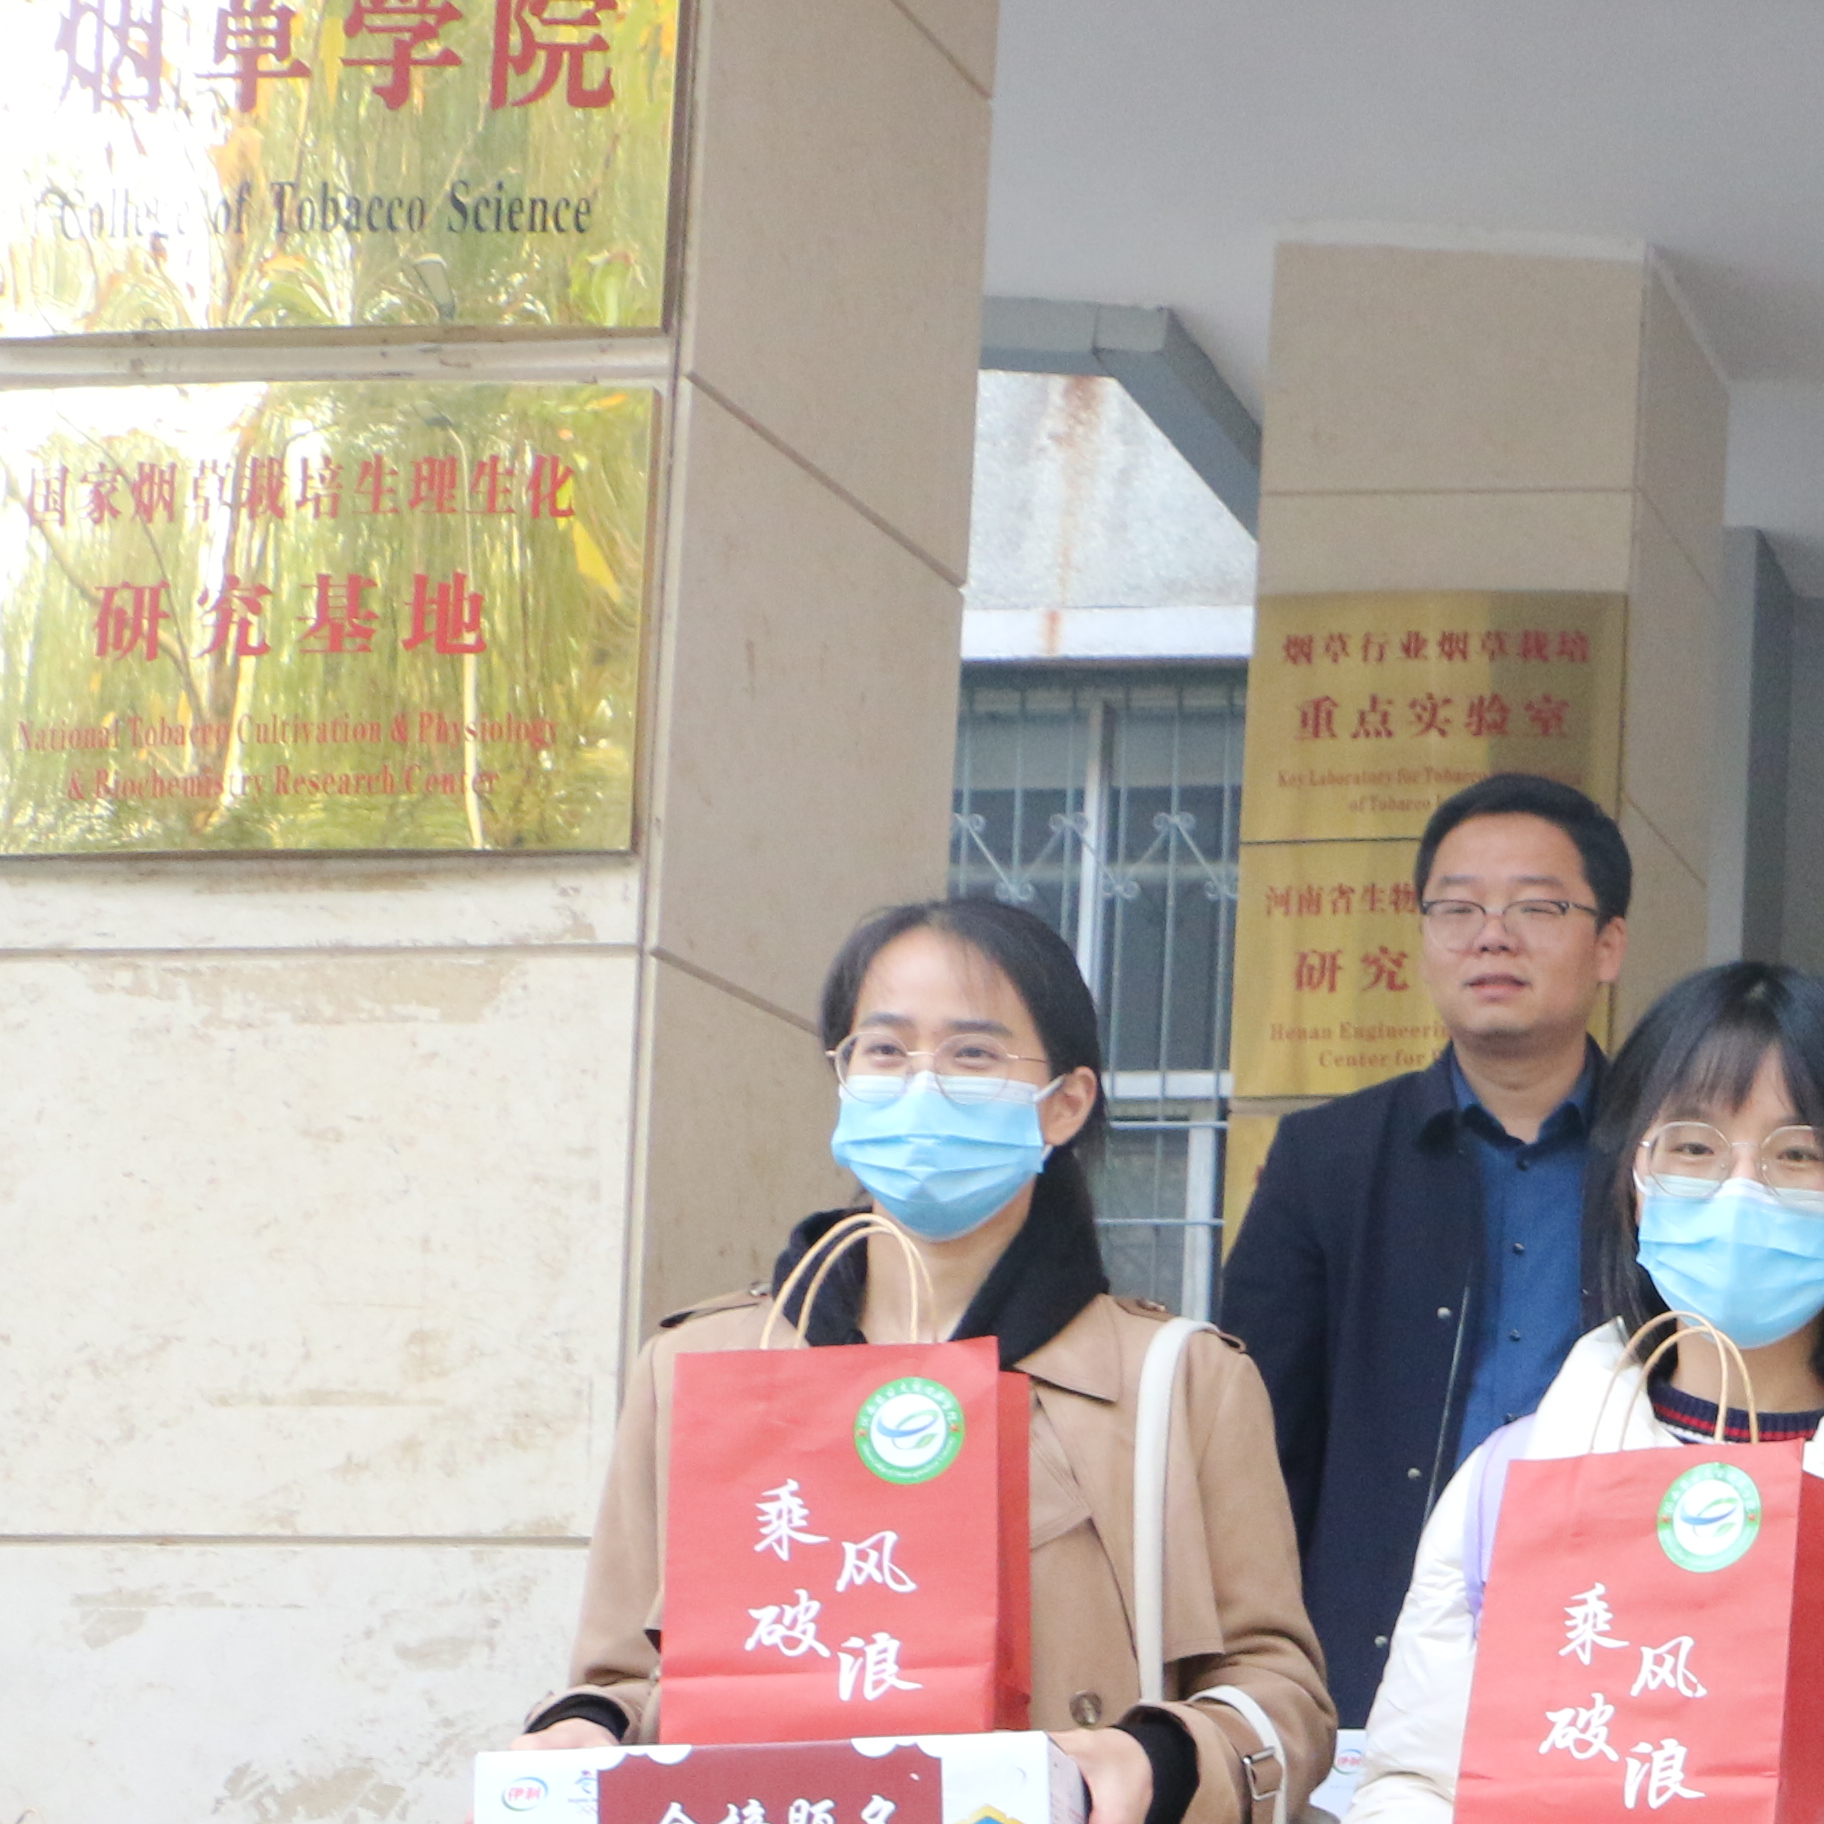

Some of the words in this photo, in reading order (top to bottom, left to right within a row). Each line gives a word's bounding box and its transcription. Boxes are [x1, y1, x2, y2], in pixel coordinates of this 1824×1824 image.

[212, 181, 252, 236] of
[270, 181, 427, 235] Tobacco
[447, 179, 593, 234] Science
[28, 453, 576, 527] 国家烟草栽培生理生化
[93, 570, 488, 662] 研究基地
[1282, 629, 1590, 667] 烟草行业烟草栽培
[17, 715, 119, 753] National
[128, 715, 229, 750] Tobacco
[236, 712, 382, 748] Cultivation
[389, 712, 410, 746] &
[418, 709, 558, 751] Physiology
[1293, 690, 1571, 741] 重点实验室
[66, 768, 85, 802] &
[93, 766, 268, 804] Biochemistry
[274, 764, 396, 798] Research
[405, 764, 499, 797] Center
[1294, 945, 1411, 994] 研究
[1319, 1049, 1388, 1068] Center
[1395, 1048, 1426, 1067] for
[753, 1478, 917, 1593] 乘风
[742, 1588, 923, 1702] 破浪
[1559, 1582, 1708, 1700] 乘风
[1538, 1691, 1706, 1811] 破浪
